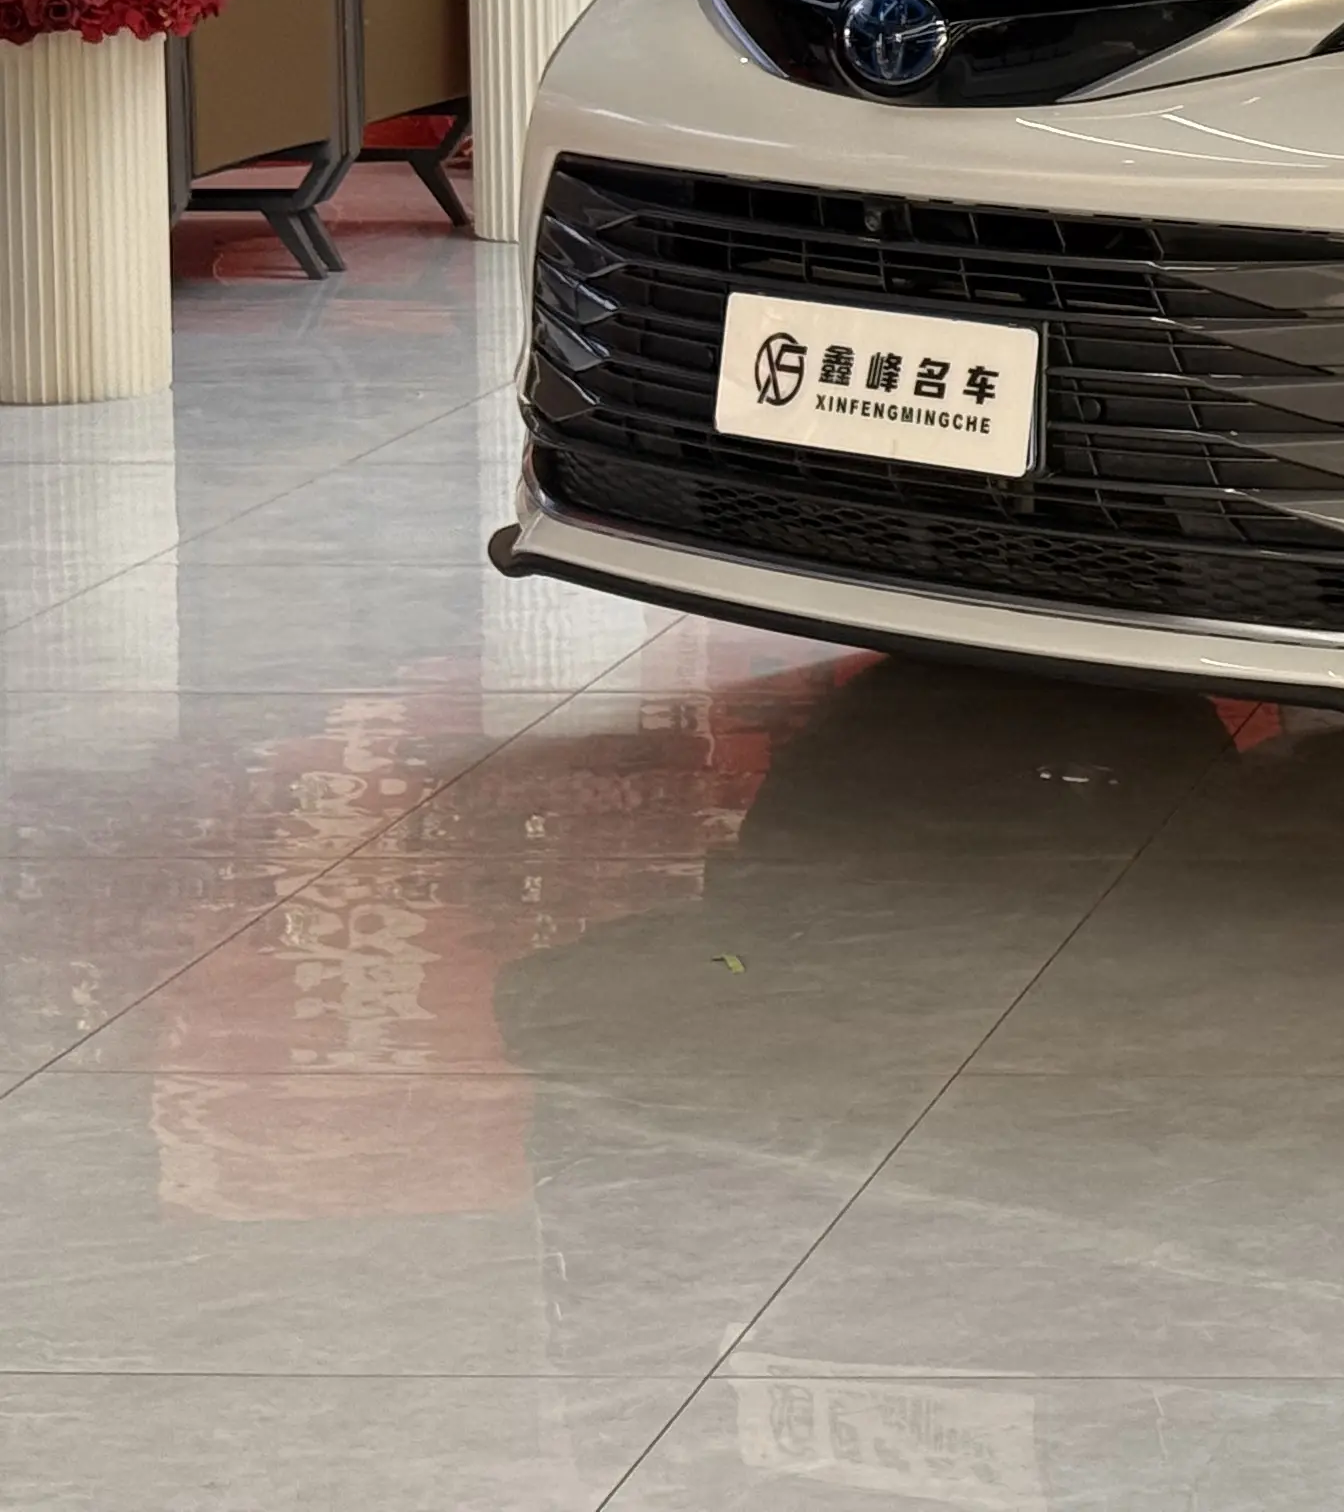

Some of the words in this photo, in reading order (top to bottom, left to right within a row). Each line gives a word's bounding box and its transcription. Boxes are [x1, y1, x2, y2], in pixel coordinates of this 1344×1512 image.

[818, 344, 1000, 405] 鑫峰名车
[815, 393, 992, 434] XINFENGMINGCHE
